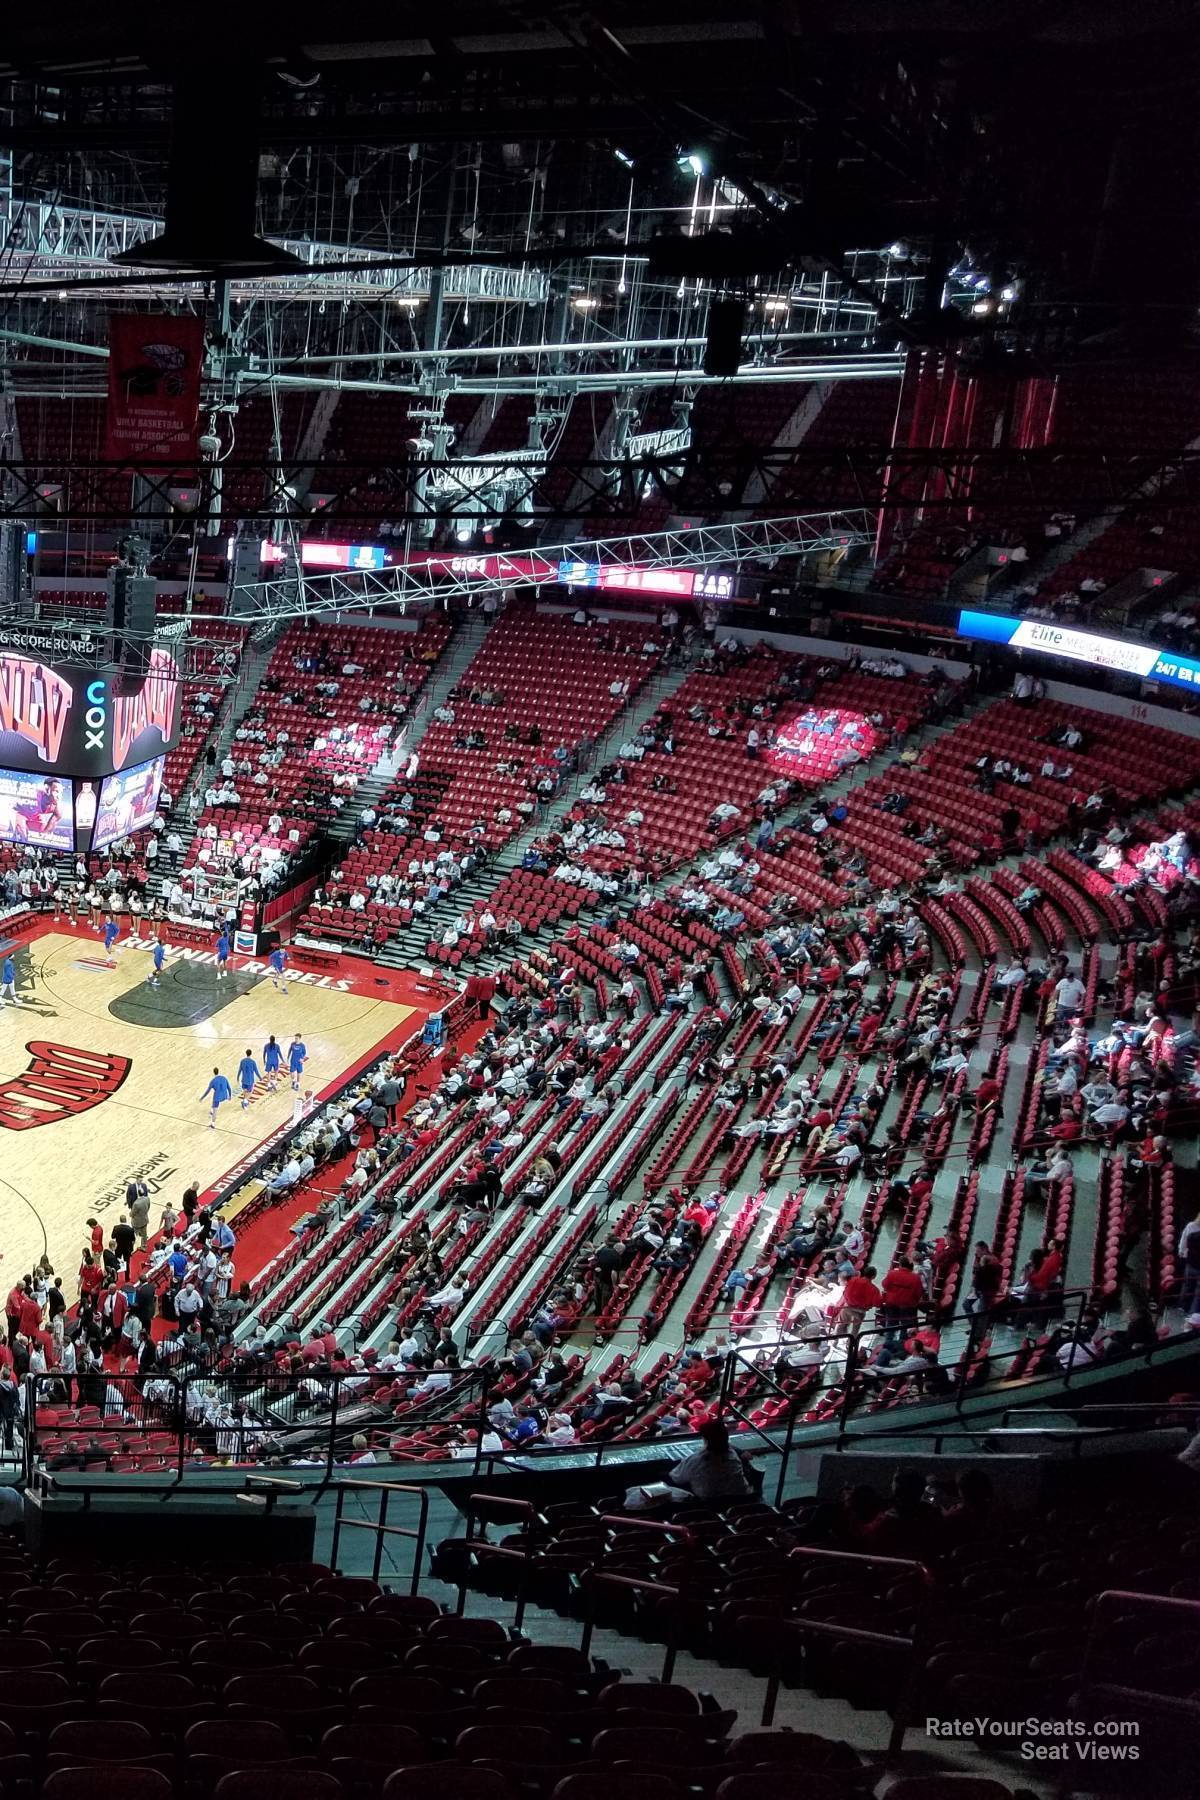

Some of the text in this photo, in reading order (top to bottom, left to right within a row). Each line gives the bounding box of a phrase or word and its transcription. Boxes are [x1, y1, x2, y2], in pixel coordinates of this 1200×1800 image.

[138, 418, 185, 429] BASKETBALL
[13, 633, 95, 654] SCOREBOARD
[1030, 624, 1063, 645] Elite
[1155, 660, 1178, 677] 24/7
[1178, 666, 1194, 682] ER
[84, 681, 106, 750] COX
[238, 960, 355, 992] REBELS
[88, 1151, 170, 1214] AMERICA FIRST
